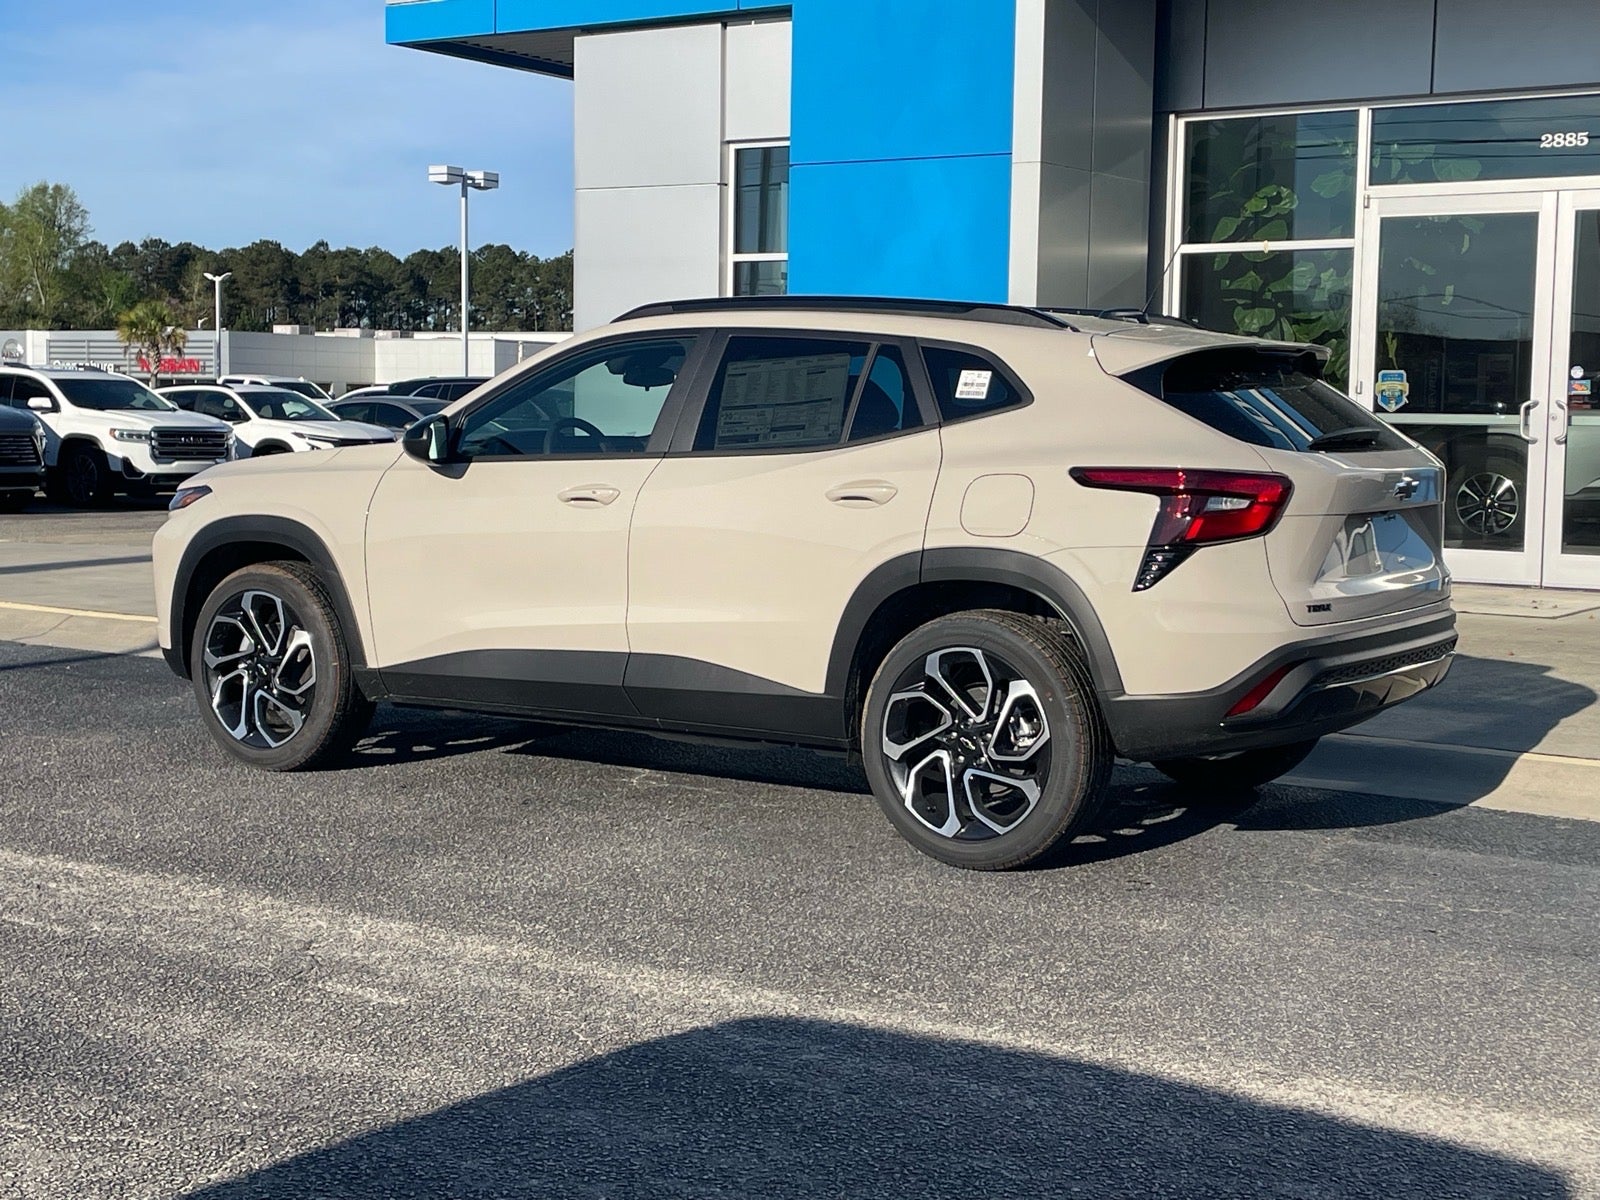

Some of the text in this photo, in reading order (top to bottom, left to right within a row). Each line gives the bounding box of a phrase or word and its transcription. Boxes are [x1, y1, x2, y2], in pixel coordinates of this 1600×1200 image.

[1540, 131, 1589, 148] 2885
[139, 358, 199, 372] NSSAN
[1306, 603, 1332, 613] TRAX
